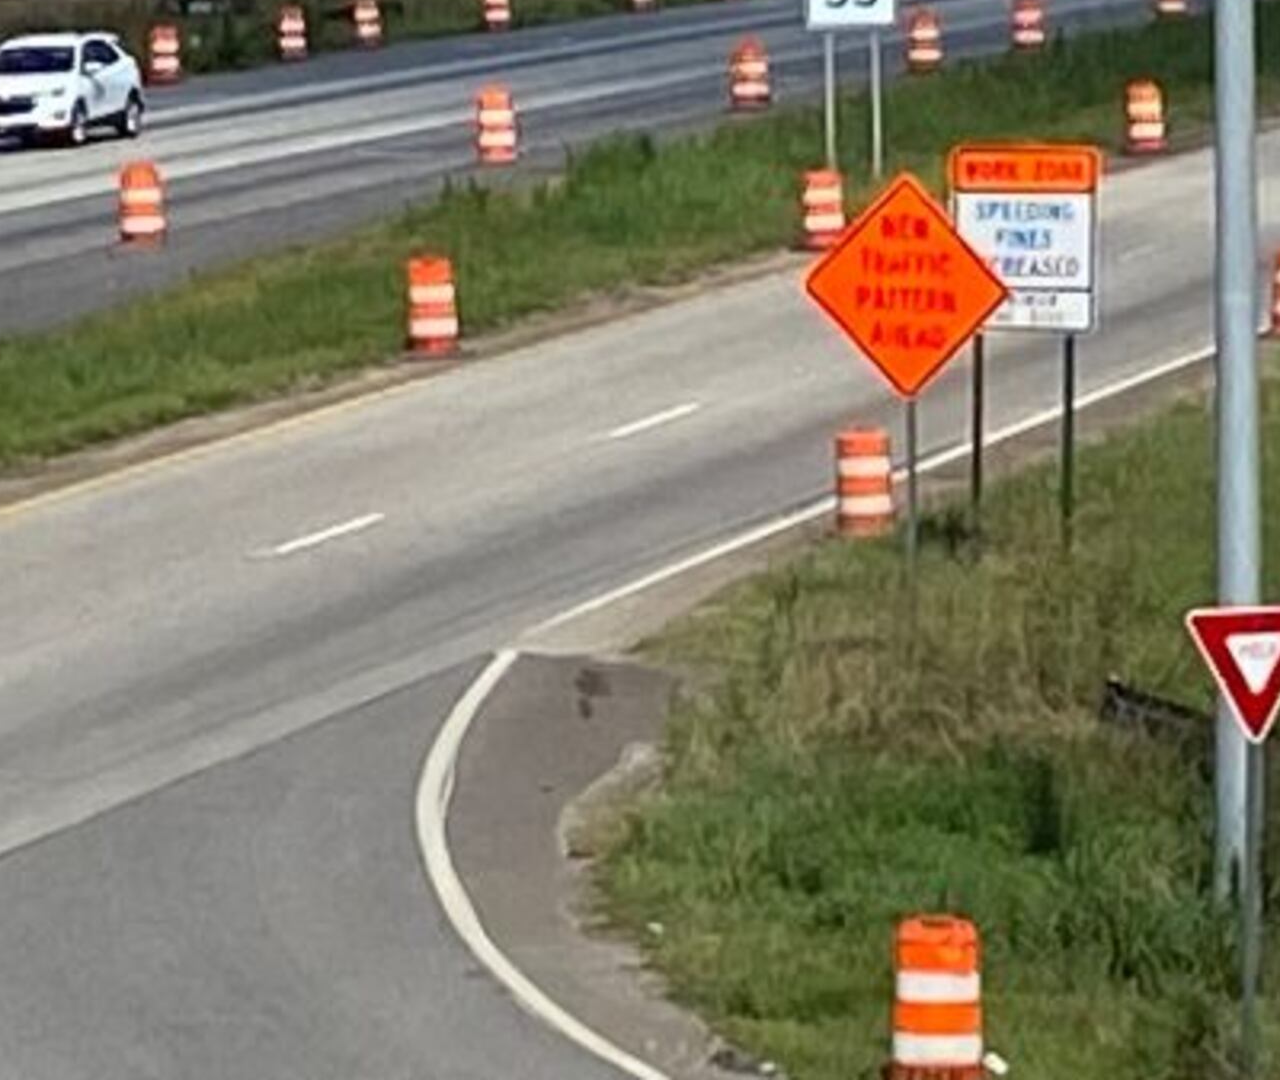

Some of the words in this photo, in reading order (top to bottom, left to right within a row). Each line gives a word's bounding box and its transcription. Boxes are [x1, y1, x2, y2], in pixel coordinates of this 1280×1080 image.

[975, 200, 1076, 222] SPEEDING
[880, 214, 929, 240] NEW
[994, 228, 1053, 250] FINES
[859, 246, 953, 278] TRAFFIC
[855, 285, 957, 314] PATTERN
